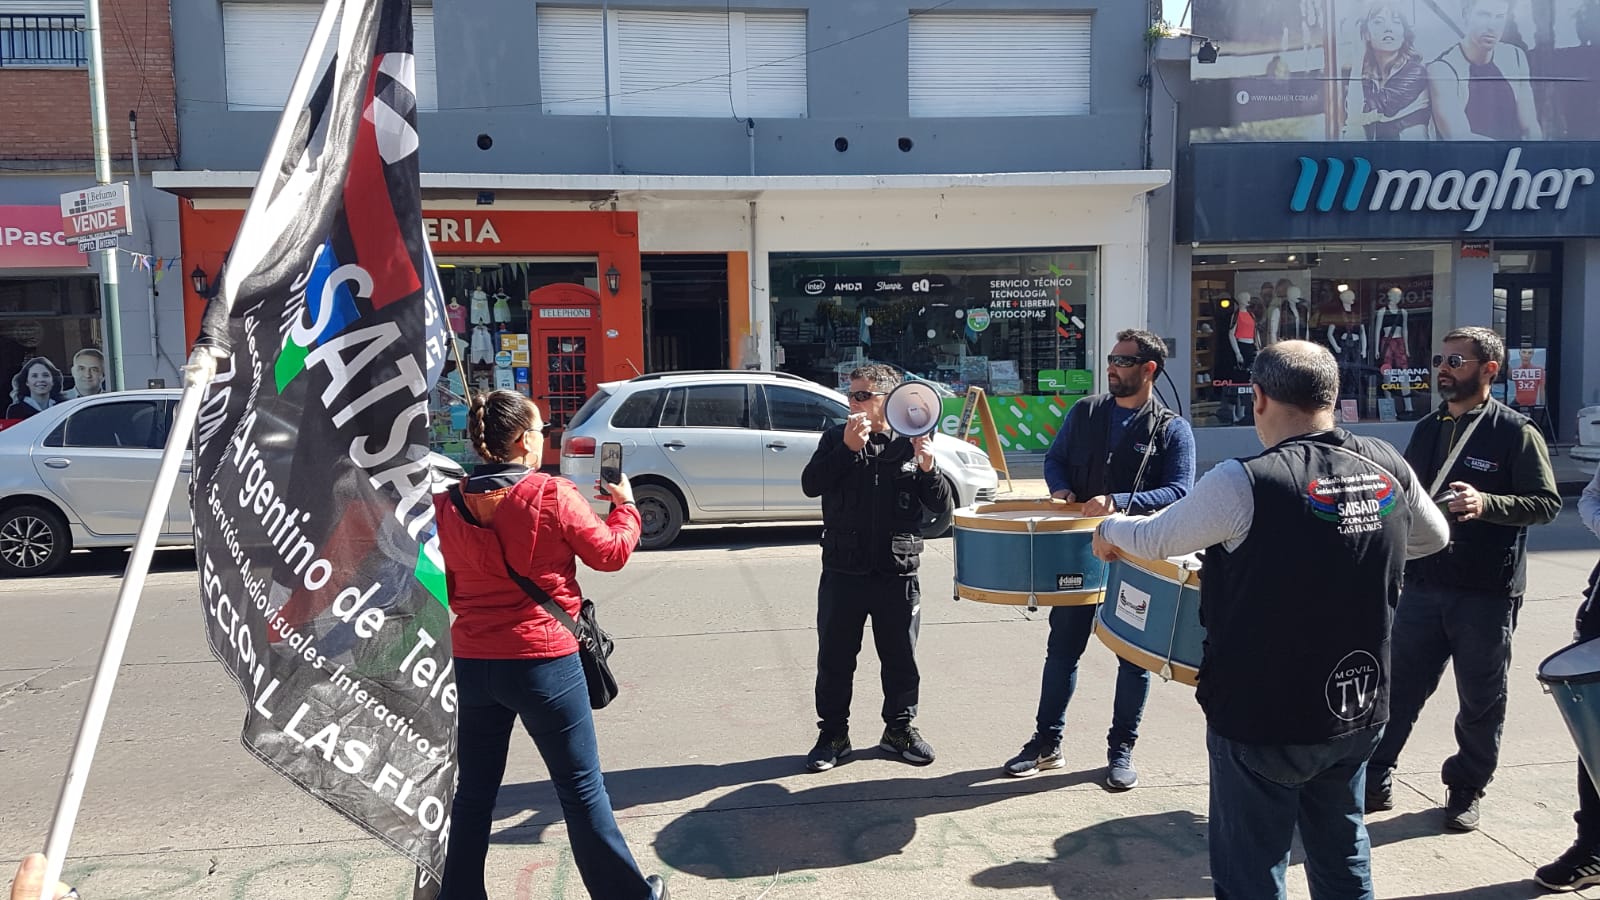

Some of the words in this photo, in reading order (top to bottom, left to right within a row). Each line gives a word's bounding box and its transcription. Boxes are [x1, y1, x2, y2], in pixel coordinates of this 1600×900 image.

[1367, 147, 1594, 232] magher
[72, 210, 117, 233] VENDE
[423, 218, 501, 243] ERIA
[834, 282, 855, 291] AMD
[990, 280, 1030, 288] SERVICIO
[1034, 277, 1072, 287] TÉCNICO
[990, 310, 1046, 319] FOTOCOPIAS
[1384, 368, 1430, 376] SEMANA
[1513, 370, 1541, 379] SALE
[1518, 380, 1536, 390] 3x2
[233, 410, 332, 591] Argentino
[332, 582, 385, 638] de
[208, 483, 244, 565] Servicios
[239, 558, 326, 669] Audiovisuales
[328, 664, 440, 760] Interactivos
[1335, 665, 1375, 679] MOVIL
[1336, 674, 1370, 713] TV
[283, 702, 373, 774] LAS
